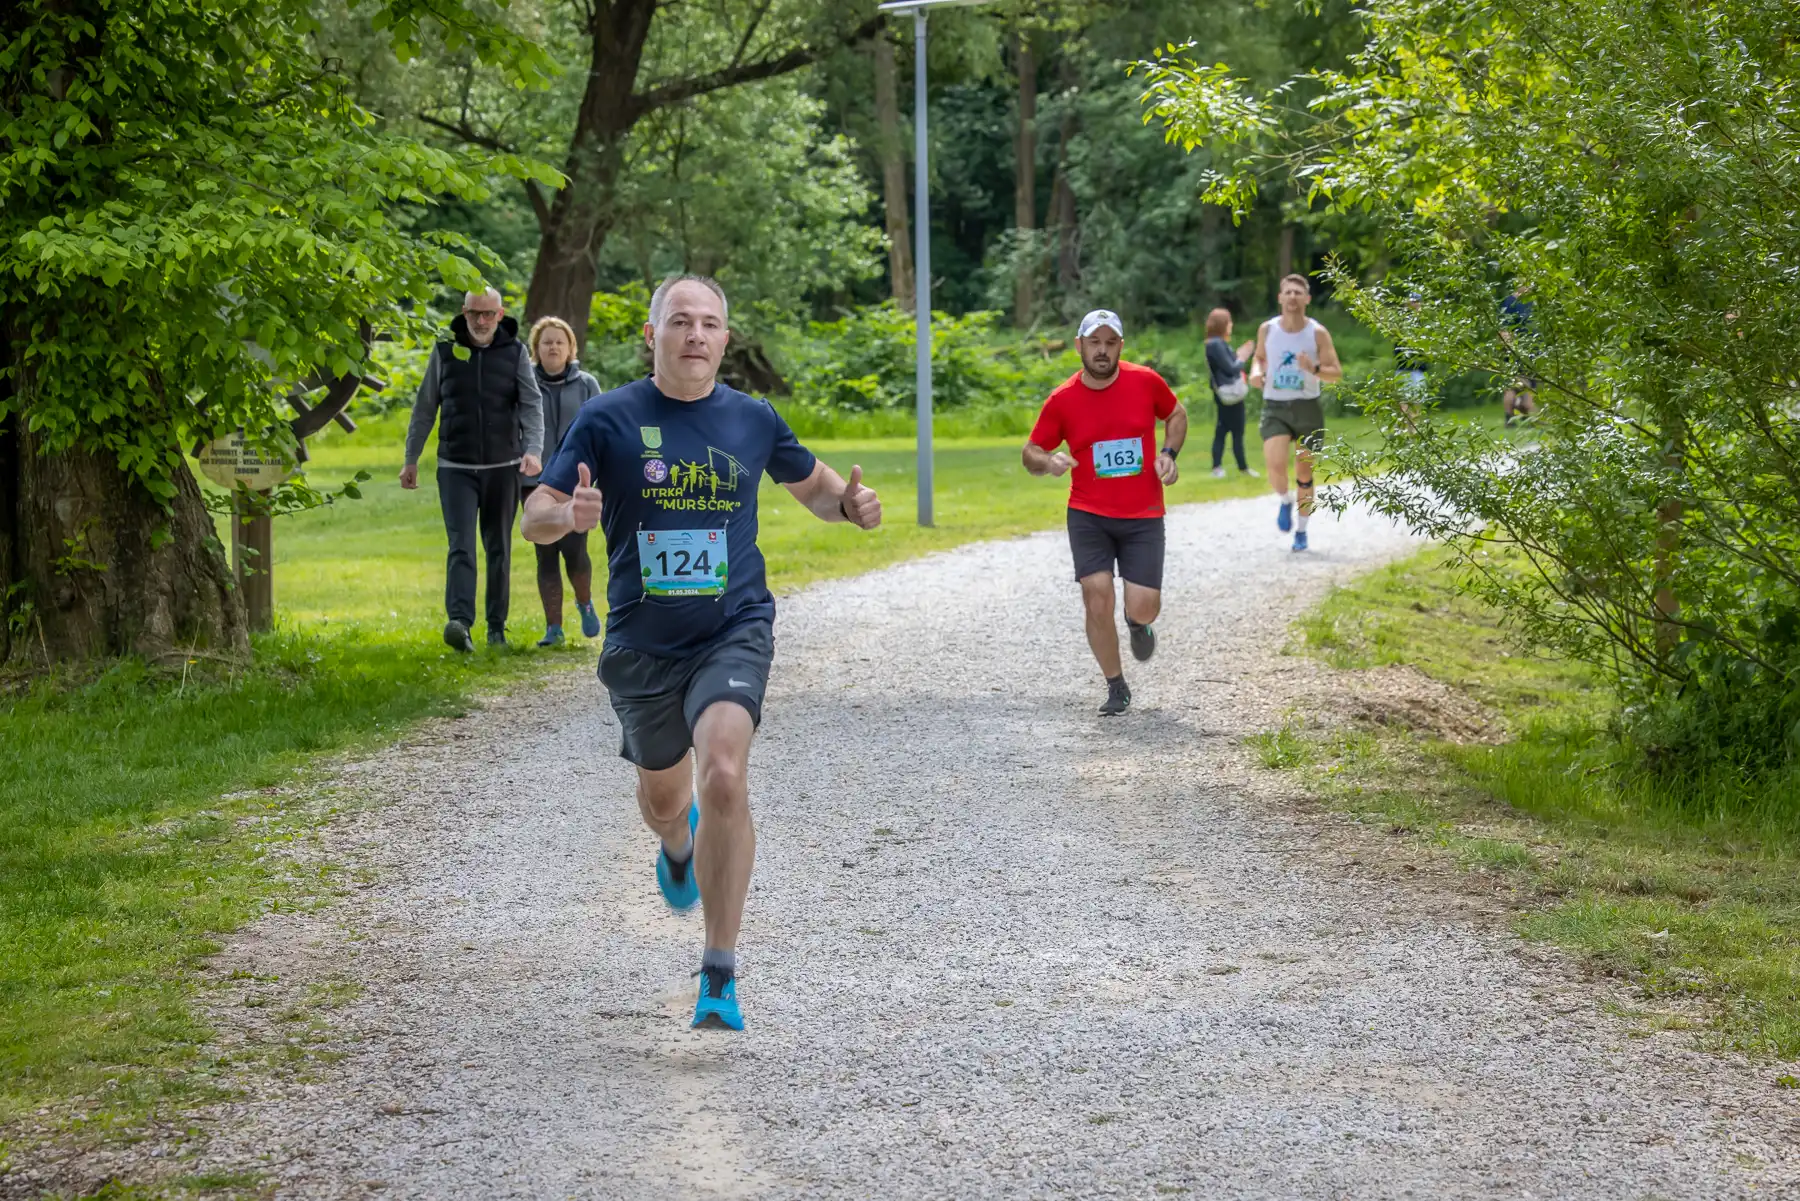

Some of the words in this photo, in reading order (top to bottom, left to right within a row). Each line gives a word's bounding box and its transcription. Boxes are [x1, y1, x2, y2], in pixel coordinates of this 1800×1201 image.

[1103, 450, 1135, 467] 163
[642, 487, 684, 498] UTRKA
[655, 550, 712, 576] 124
